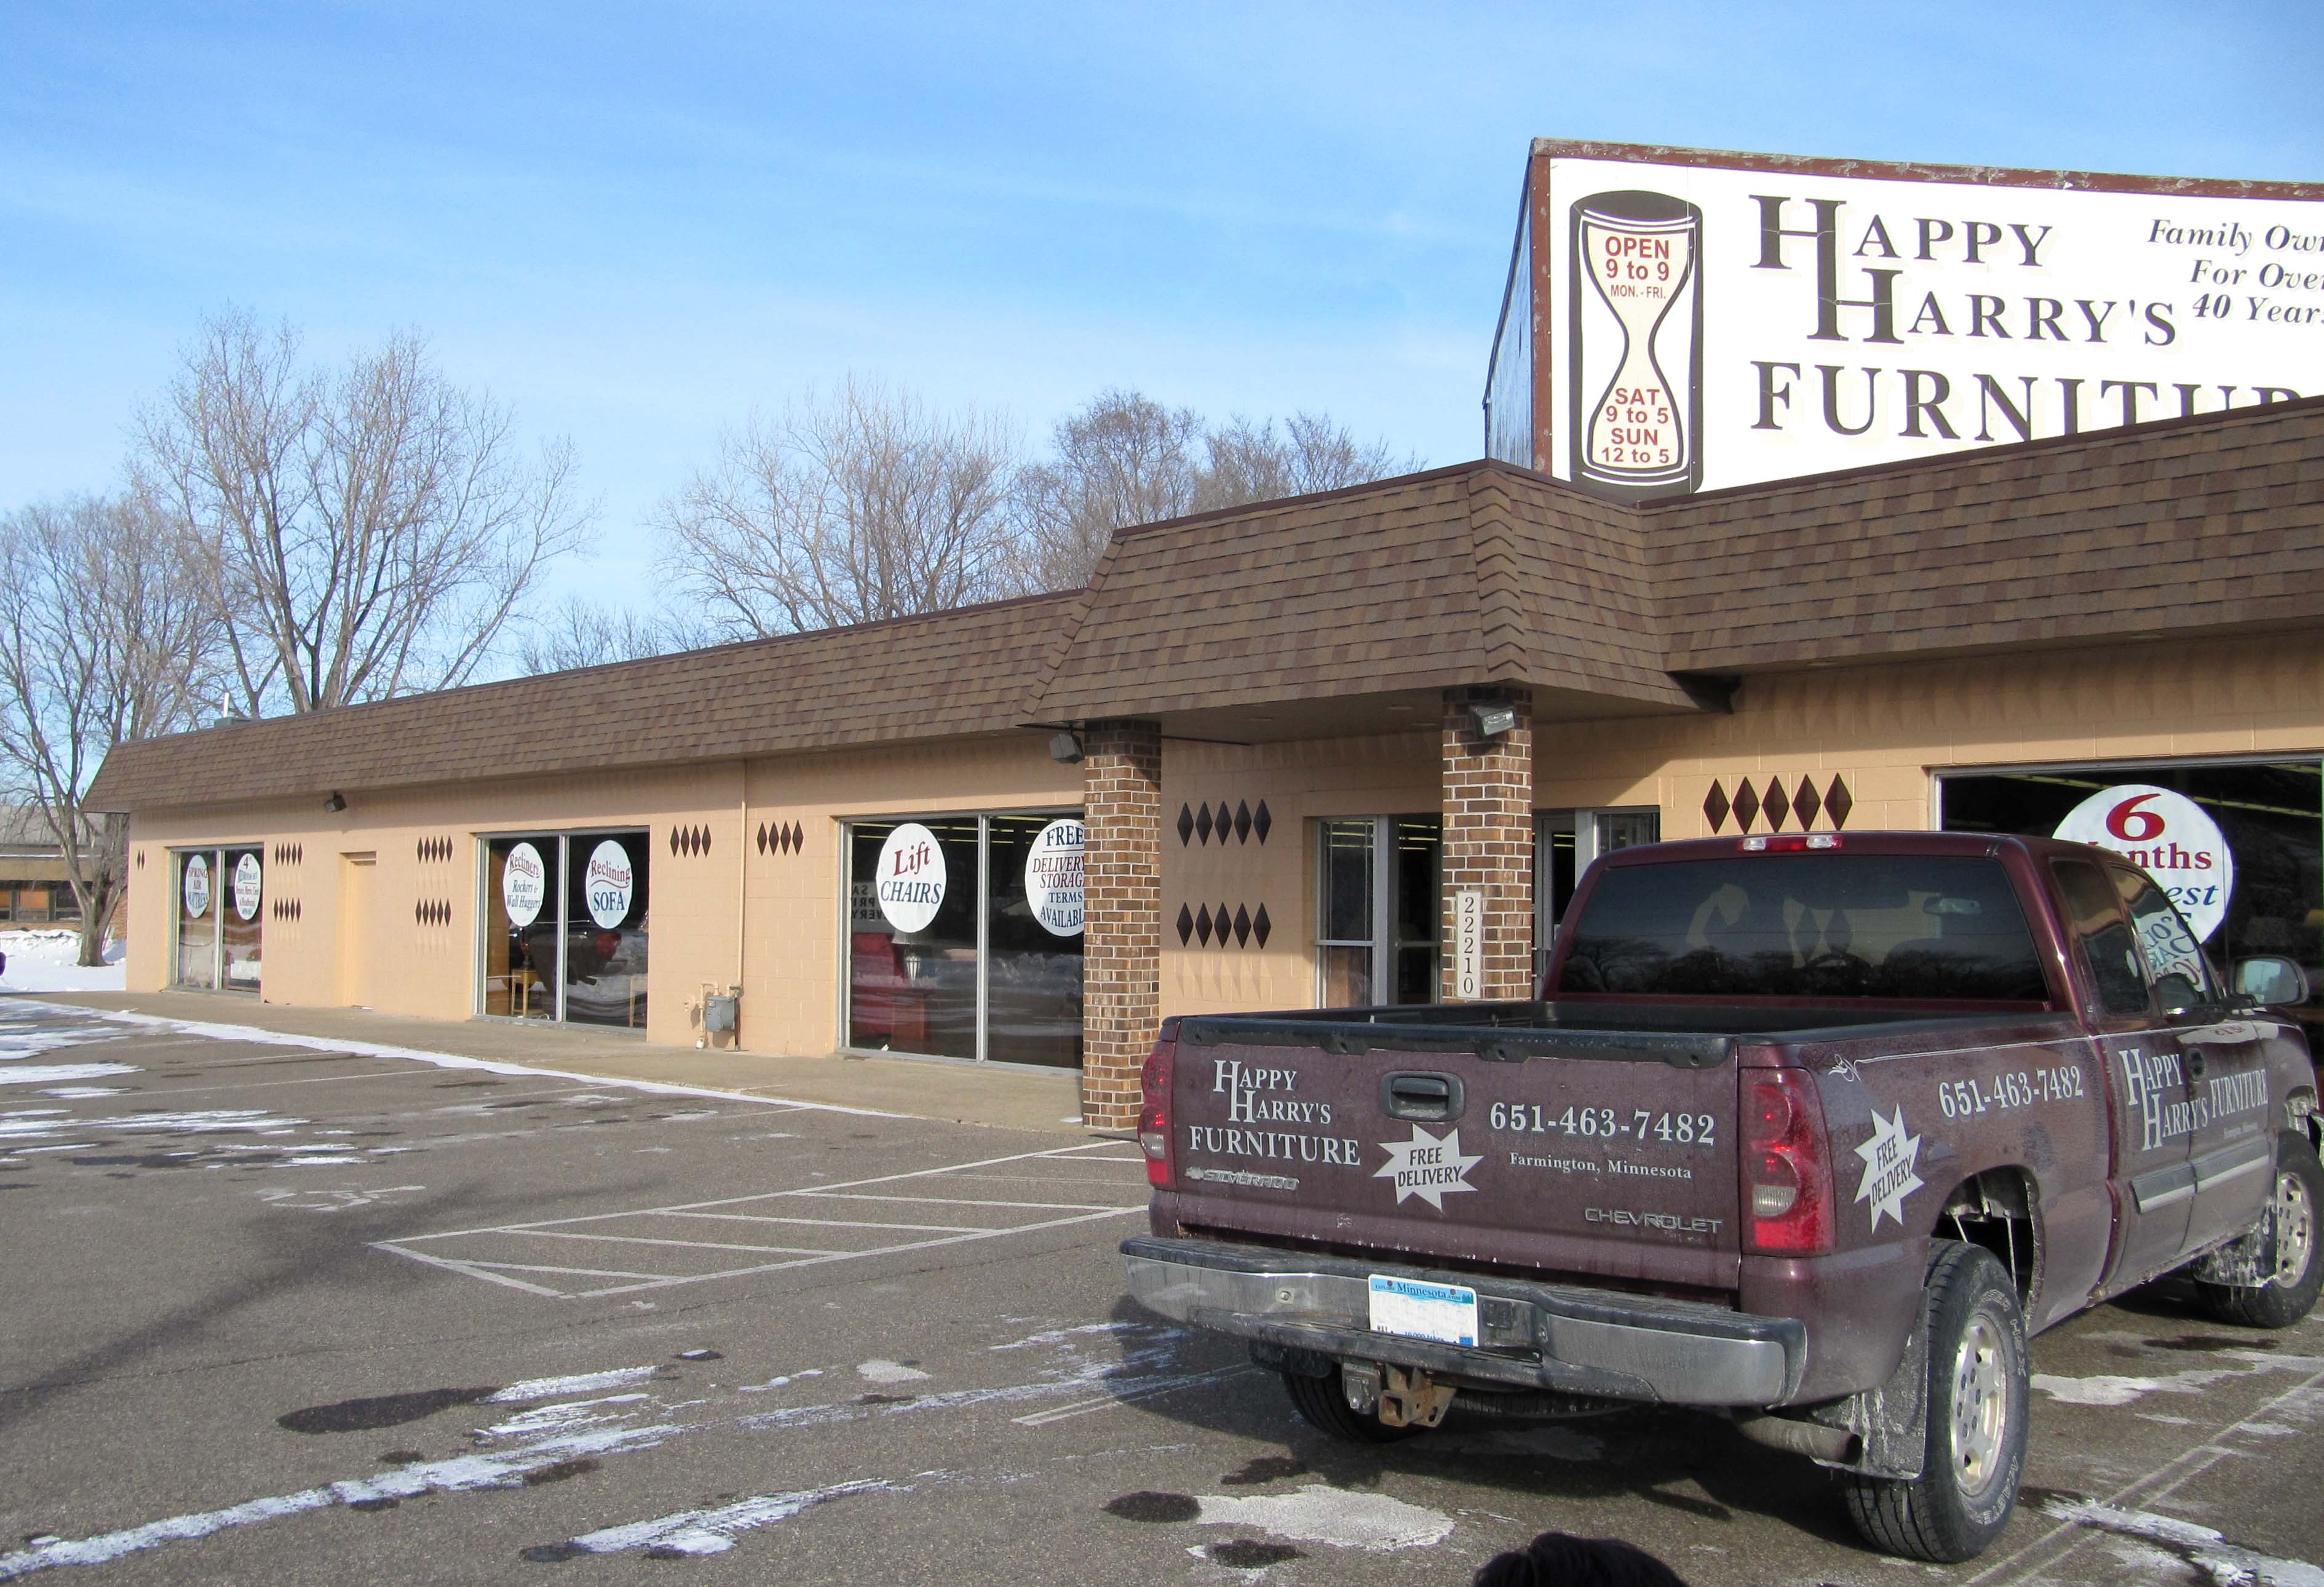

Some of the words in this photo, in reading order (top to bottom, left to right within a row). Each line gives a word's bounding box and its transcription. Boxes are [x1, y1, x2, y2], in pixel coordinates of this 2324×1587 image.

[1748, 194, 2053, 269] HAPPY
[2147, 219, 2252, 257] Family
[2265, 225, 2324, 252] Ow
[1605, 236, 1669, 260] OPEN
[1606, 258, 1618, 279] 9
[1627, 261, 1649, 280] to
[1657, 261, 1669, 281] 9
[2189, 259, 2247, 285] For
[2259, 263, 2324, 290] Ove
[1807, 266, 2176, 346] HARRY'S
[2192, 293, 2231, 319] 40
[2247, 296, 2324, 324] Year
[1615, 388, 1660, 405] SAT
[1750, 360, 2301, 442] FURNIT
[1606, 405, 1618, 423] 9
[1626, 407, 1648, 423] to
[1657, 407, 1668, 424] 5
[1611, 428, 1658, 445] SUN
[1601, 447, 1624, 463] 12
[1632, 448, 1651, 463] to
[1659, 448, 1670, 464] 5
[2106, 793, 2165, 841] 6
[1046, 825, 1084, 846] FREE
[893, 841, 930, 876] Lift
[2088, 841, 2212, 869] nths
[590, 860, 631, 884] Reclining
[1040, 872, 1084, 889] STORAG
[507, 895, 519, 907] Wall
[593, 891, 625, 911] SOFA
[881, 880, 942, 904] CHAIRS
[1049, 893, 1083, 904] TERMS
[1041, 905, 1084, 928] AVAILABL
[1464, 896, 1474, 994] 22210
[1213, 1059, 1297, 1092] HAPPY
[2119, 1048, 2183, 1105] HAPPY
[1938, 1065, 2084, 1118] 651-463-7482
[2209, 1069, 2269, 1119] FURNITURE
[1228, 1089, 1331, 1124] HARRY'S
[1490, 1102, 1715, 1147] 651-463-7482
[2142, 1093, 2208, 1151] HARRY'S
[1189, 1126, 1361, 1166] FURNITURE
[1410, 1147, 1443, 1166] FREE
[1876, 1134, 1898, 1171] FREE
[1398, 1166, 1462, 1187] DELIVERY
[1510, 1152, 1600, 1174] Farmington,
[1608, 1159, 1692, 1179] Minnesota
[1204, 1169, 1299, 1191] SILVERADO
[1871, 1154, 1911, 1207] DELIVERY
[1584, 1207, 1723, 1234] CHEVROLET
